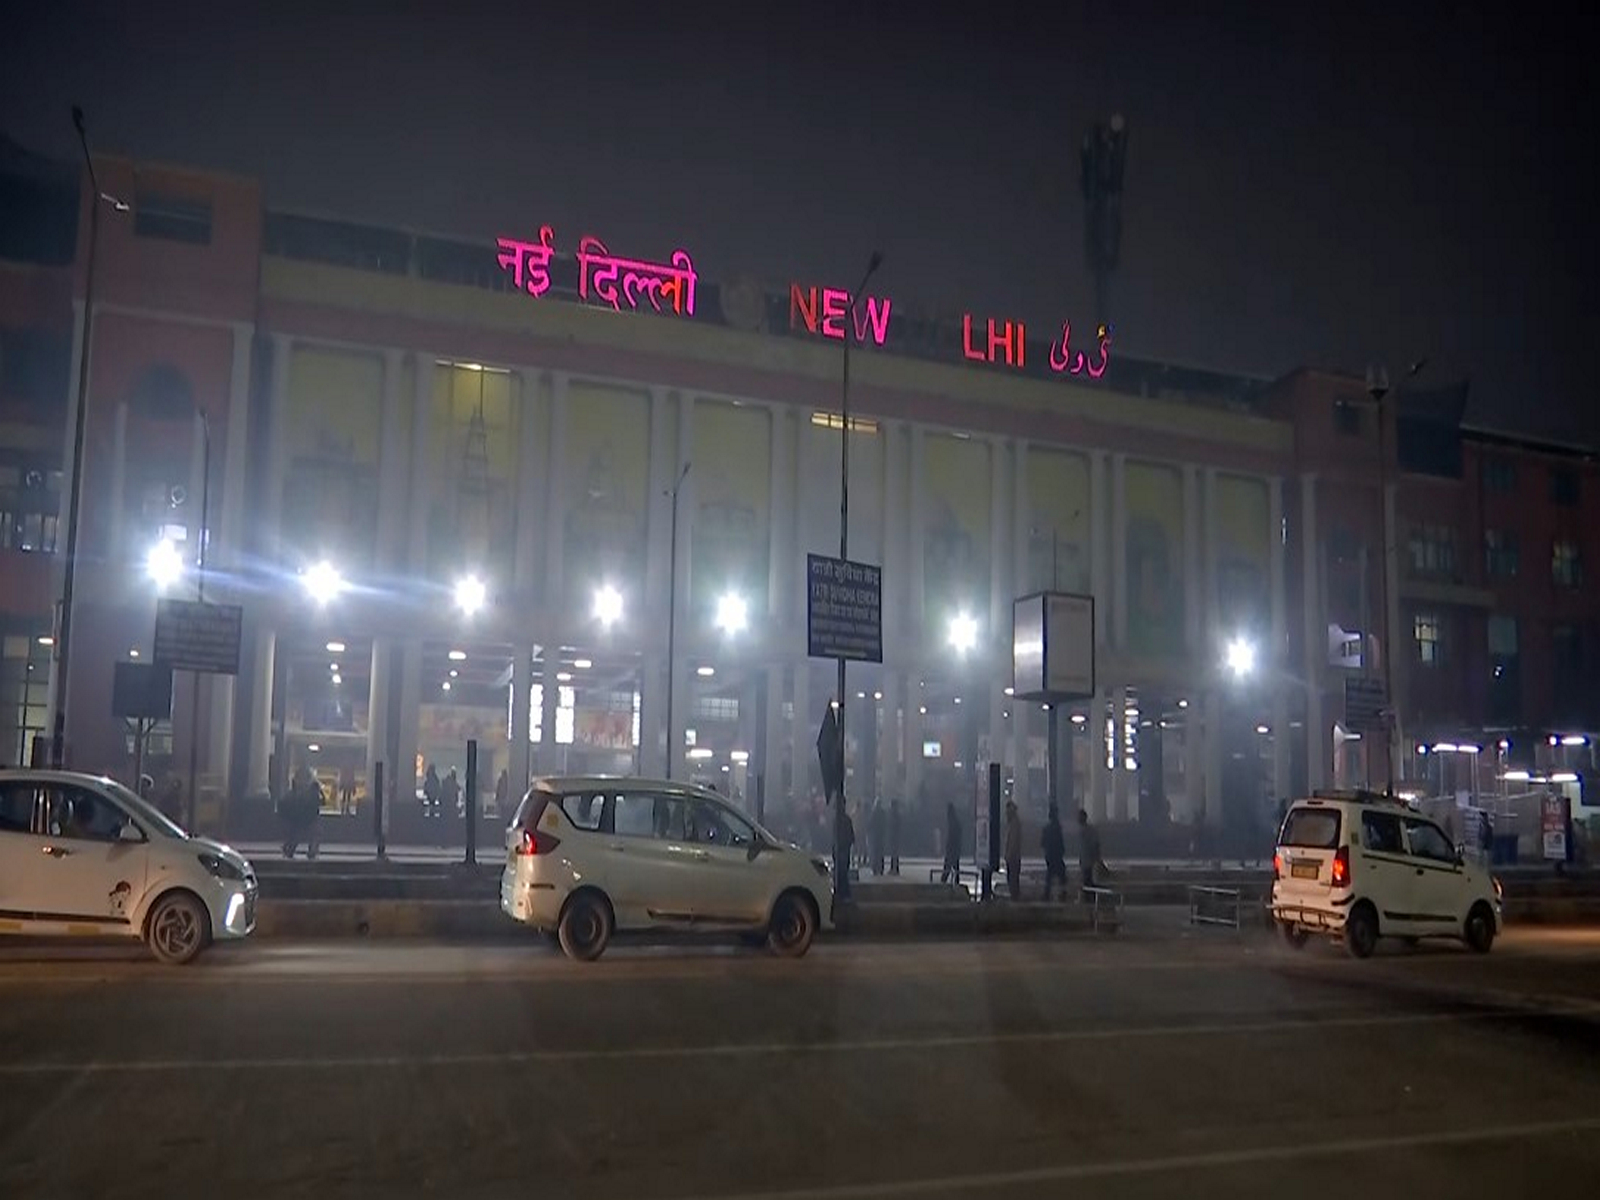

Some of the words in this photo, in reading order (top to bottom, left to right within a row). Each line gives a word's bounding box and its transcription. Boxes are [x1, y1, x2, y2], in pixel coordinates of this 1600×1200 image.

[496, 224, 554, 298] नई
[576, 234, 698, 316] दिल्ली
[790, 282, 892, 346] NEW
